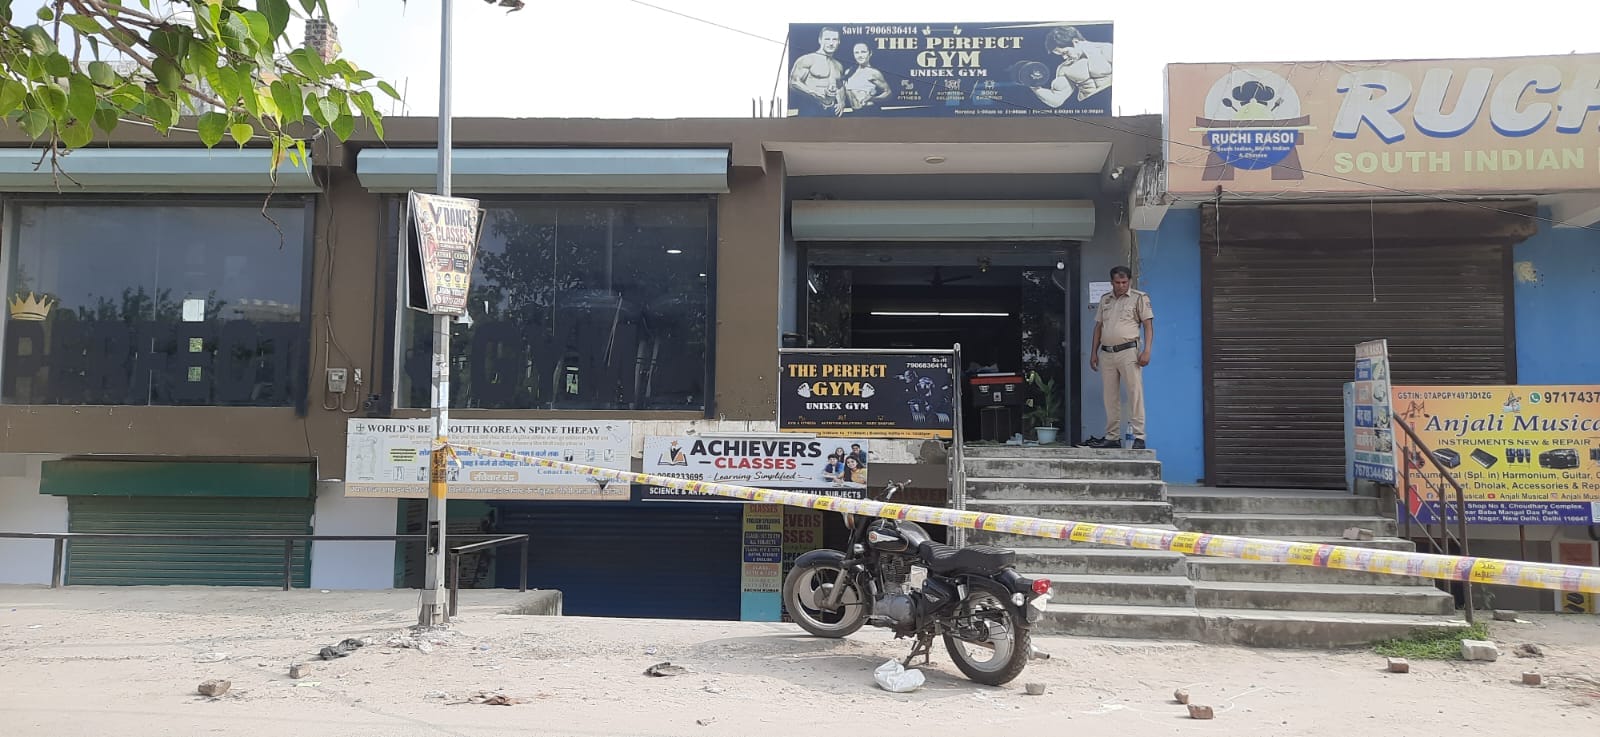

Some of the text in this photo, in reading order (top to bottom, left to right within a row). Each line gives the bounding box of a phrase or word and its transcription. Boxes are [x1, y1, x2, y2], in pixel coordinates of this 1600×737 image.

[865, 26, 918, 34] 7906836414
[874, 36, 1024, 50] THE PERFECT
[916, 52, 981, 68] GYM
[910, 69, 988, 77] UNISEX GYM
[1212, 133, 1294, 144] RUCHI RASOI
[1334, 147, 1585, 174] SOUTH INDIAN
[436, 226, 468, 243] CLASSES
[788, 364, 887, 378] THE PERFECT
[812, 382, 861, 396] GYM
[483, 426, 526, 434] KOREAN
[528, 426, 558, 434] SPINE
[561, 426, 600, 435] THEPAY
[1424, 414, 1504, 436] Anjali
[690, 440, 821, 458] ACHIEVERS
[715, 457, 796, 469] CLASSES
[714, 472, 751, 482] Learning
[754, 472, 798, 481] Simplified
[1488, 472, 1499, 480] in)
[1502, 472, 1559, 480] Harmonium,
[1562, 472, 1592, 480] Guitar,
[650, 487, 679, 495] SCIENCE
[1474, 482, 1509, 490] Dholak,
